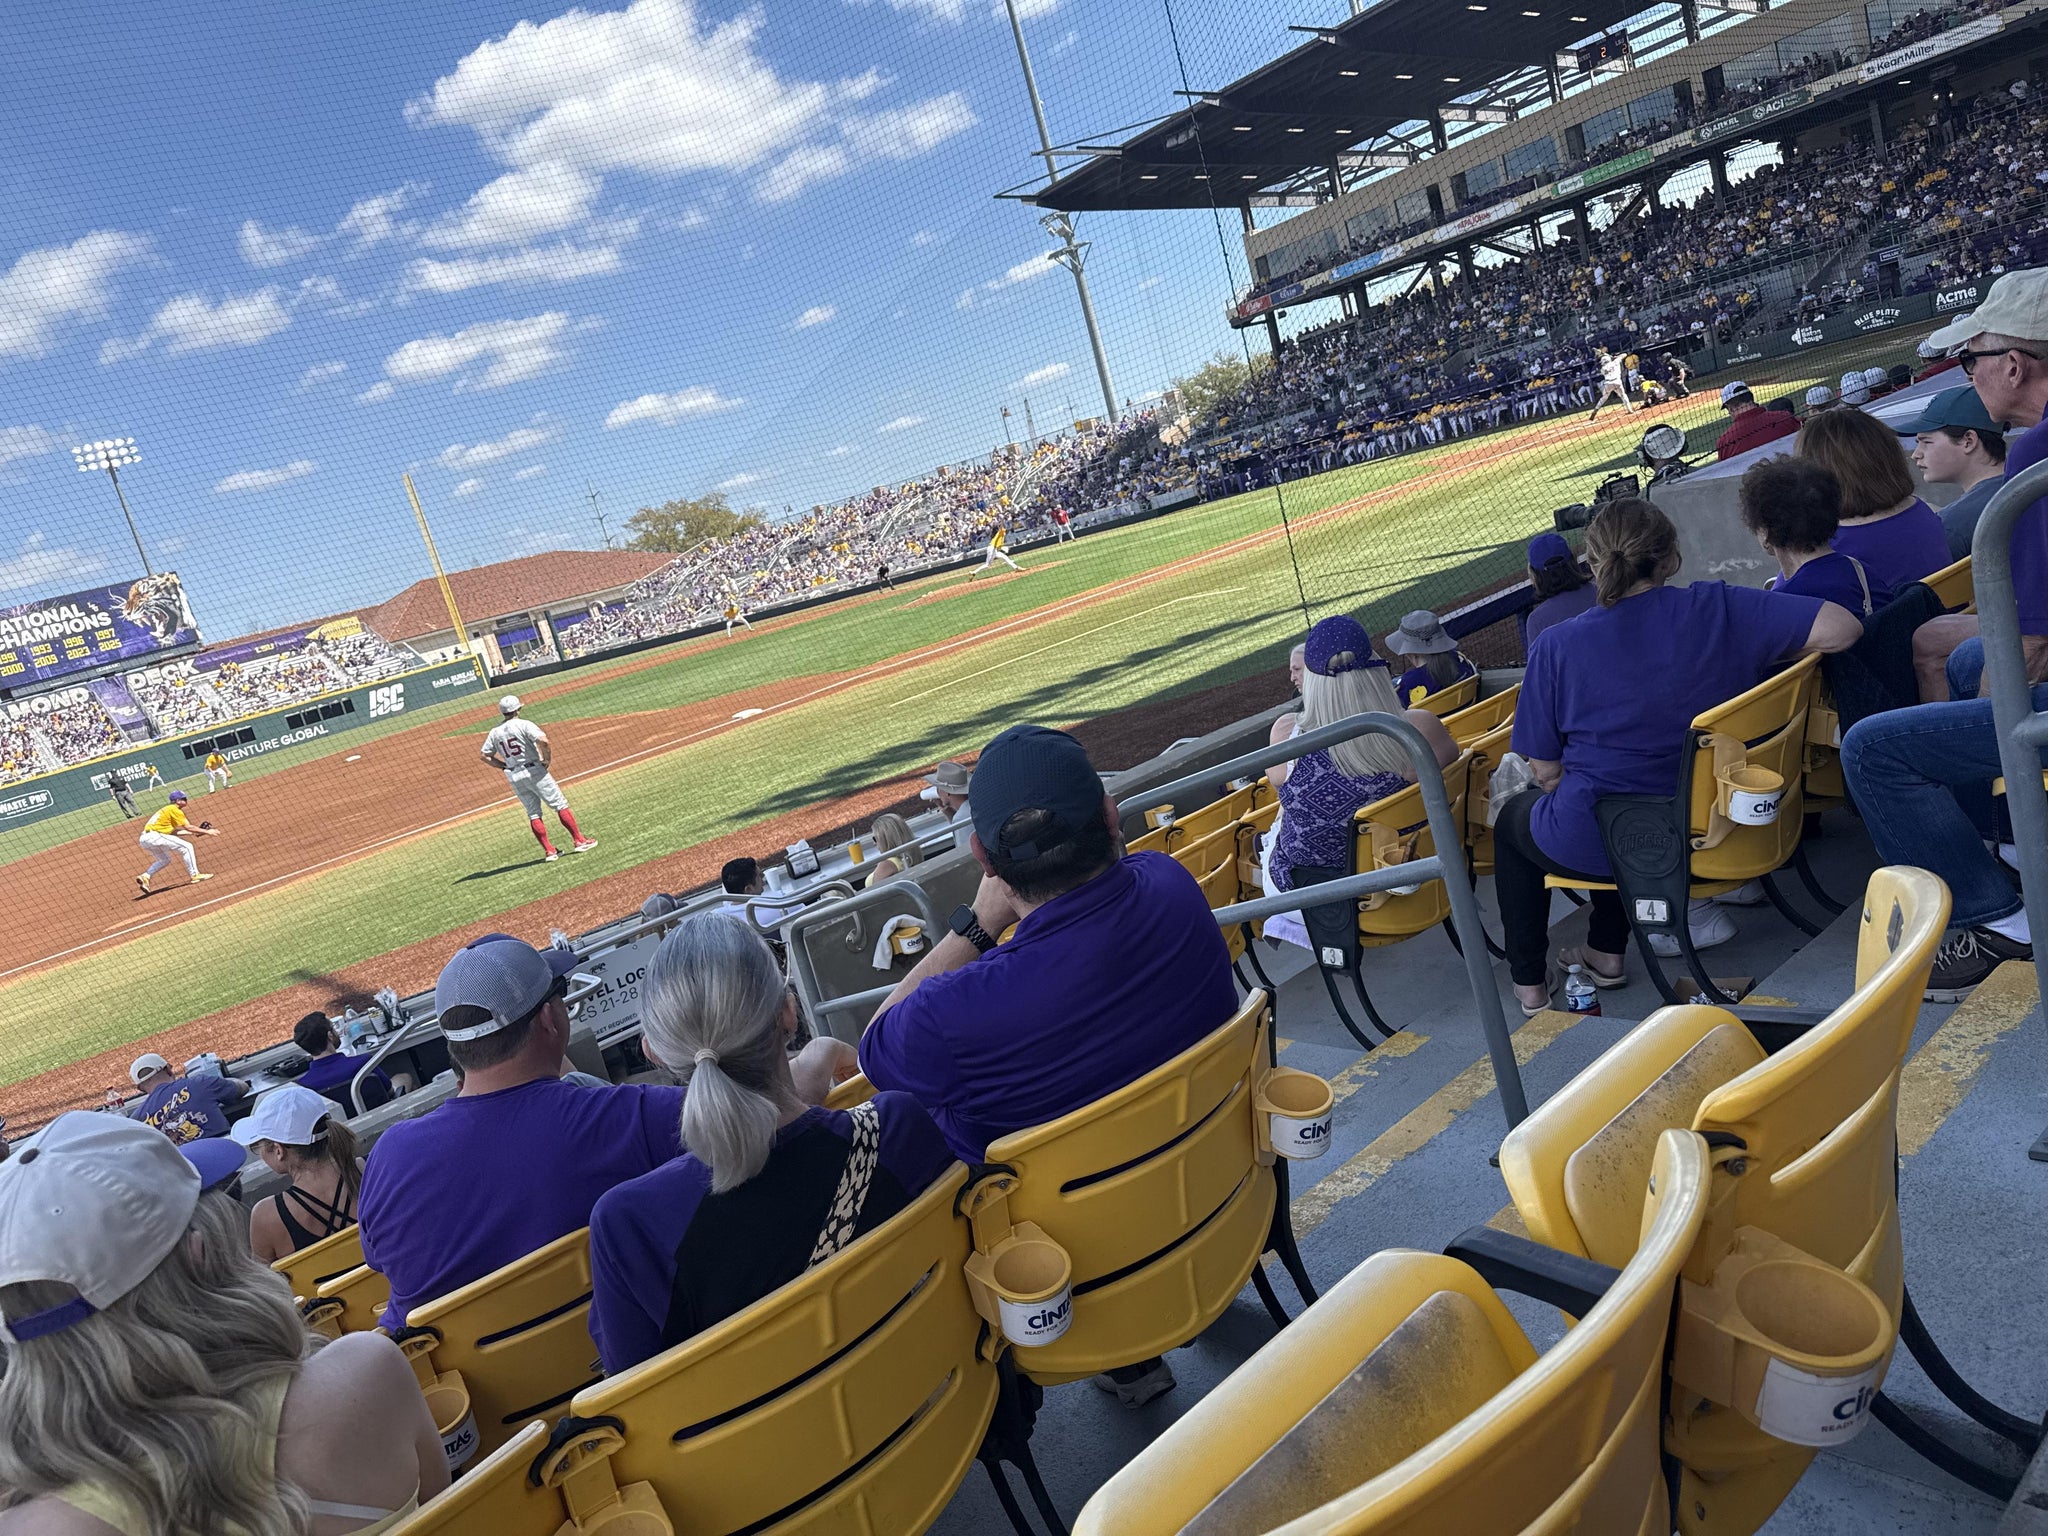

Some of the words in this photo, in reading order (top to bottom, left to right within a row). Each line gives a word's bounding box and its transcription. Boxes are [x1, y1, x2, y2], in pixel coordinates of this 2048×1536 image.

[1765, 99, 1785, 114] ACI
[1936, 287, 1977, 306] Acme
[1854, 312, 1875, 326] BLUE
[1875, 308, 1901, 317] PLATE
[30, 643, 53, 656] 1993
[62, 635, 85, 648] 1996
[94, 628, 116, 640] 1997
[0, 662, 25, 676] 2000
[33, 654, 58, 668] 2009
[127, 658, 200, 691] DECK
[368, 682, 405, 718] ISC
[222, 738, 280, 762] VENTURE
[280, 724, 329, 746] GLOBAL
[499, 736, 523, 758] 15
[0, 798, 28, 814] WASTE
[28, 792, 48, 805] PRO
[1646, 901, 1657, 920] 4
[1329, 948, 1336, 964] 3
[616, 966, 648, 989] LOG
[600, 986, 638, 1013] 21-28
[607, 1012, 638, 1030] REQUIRED
